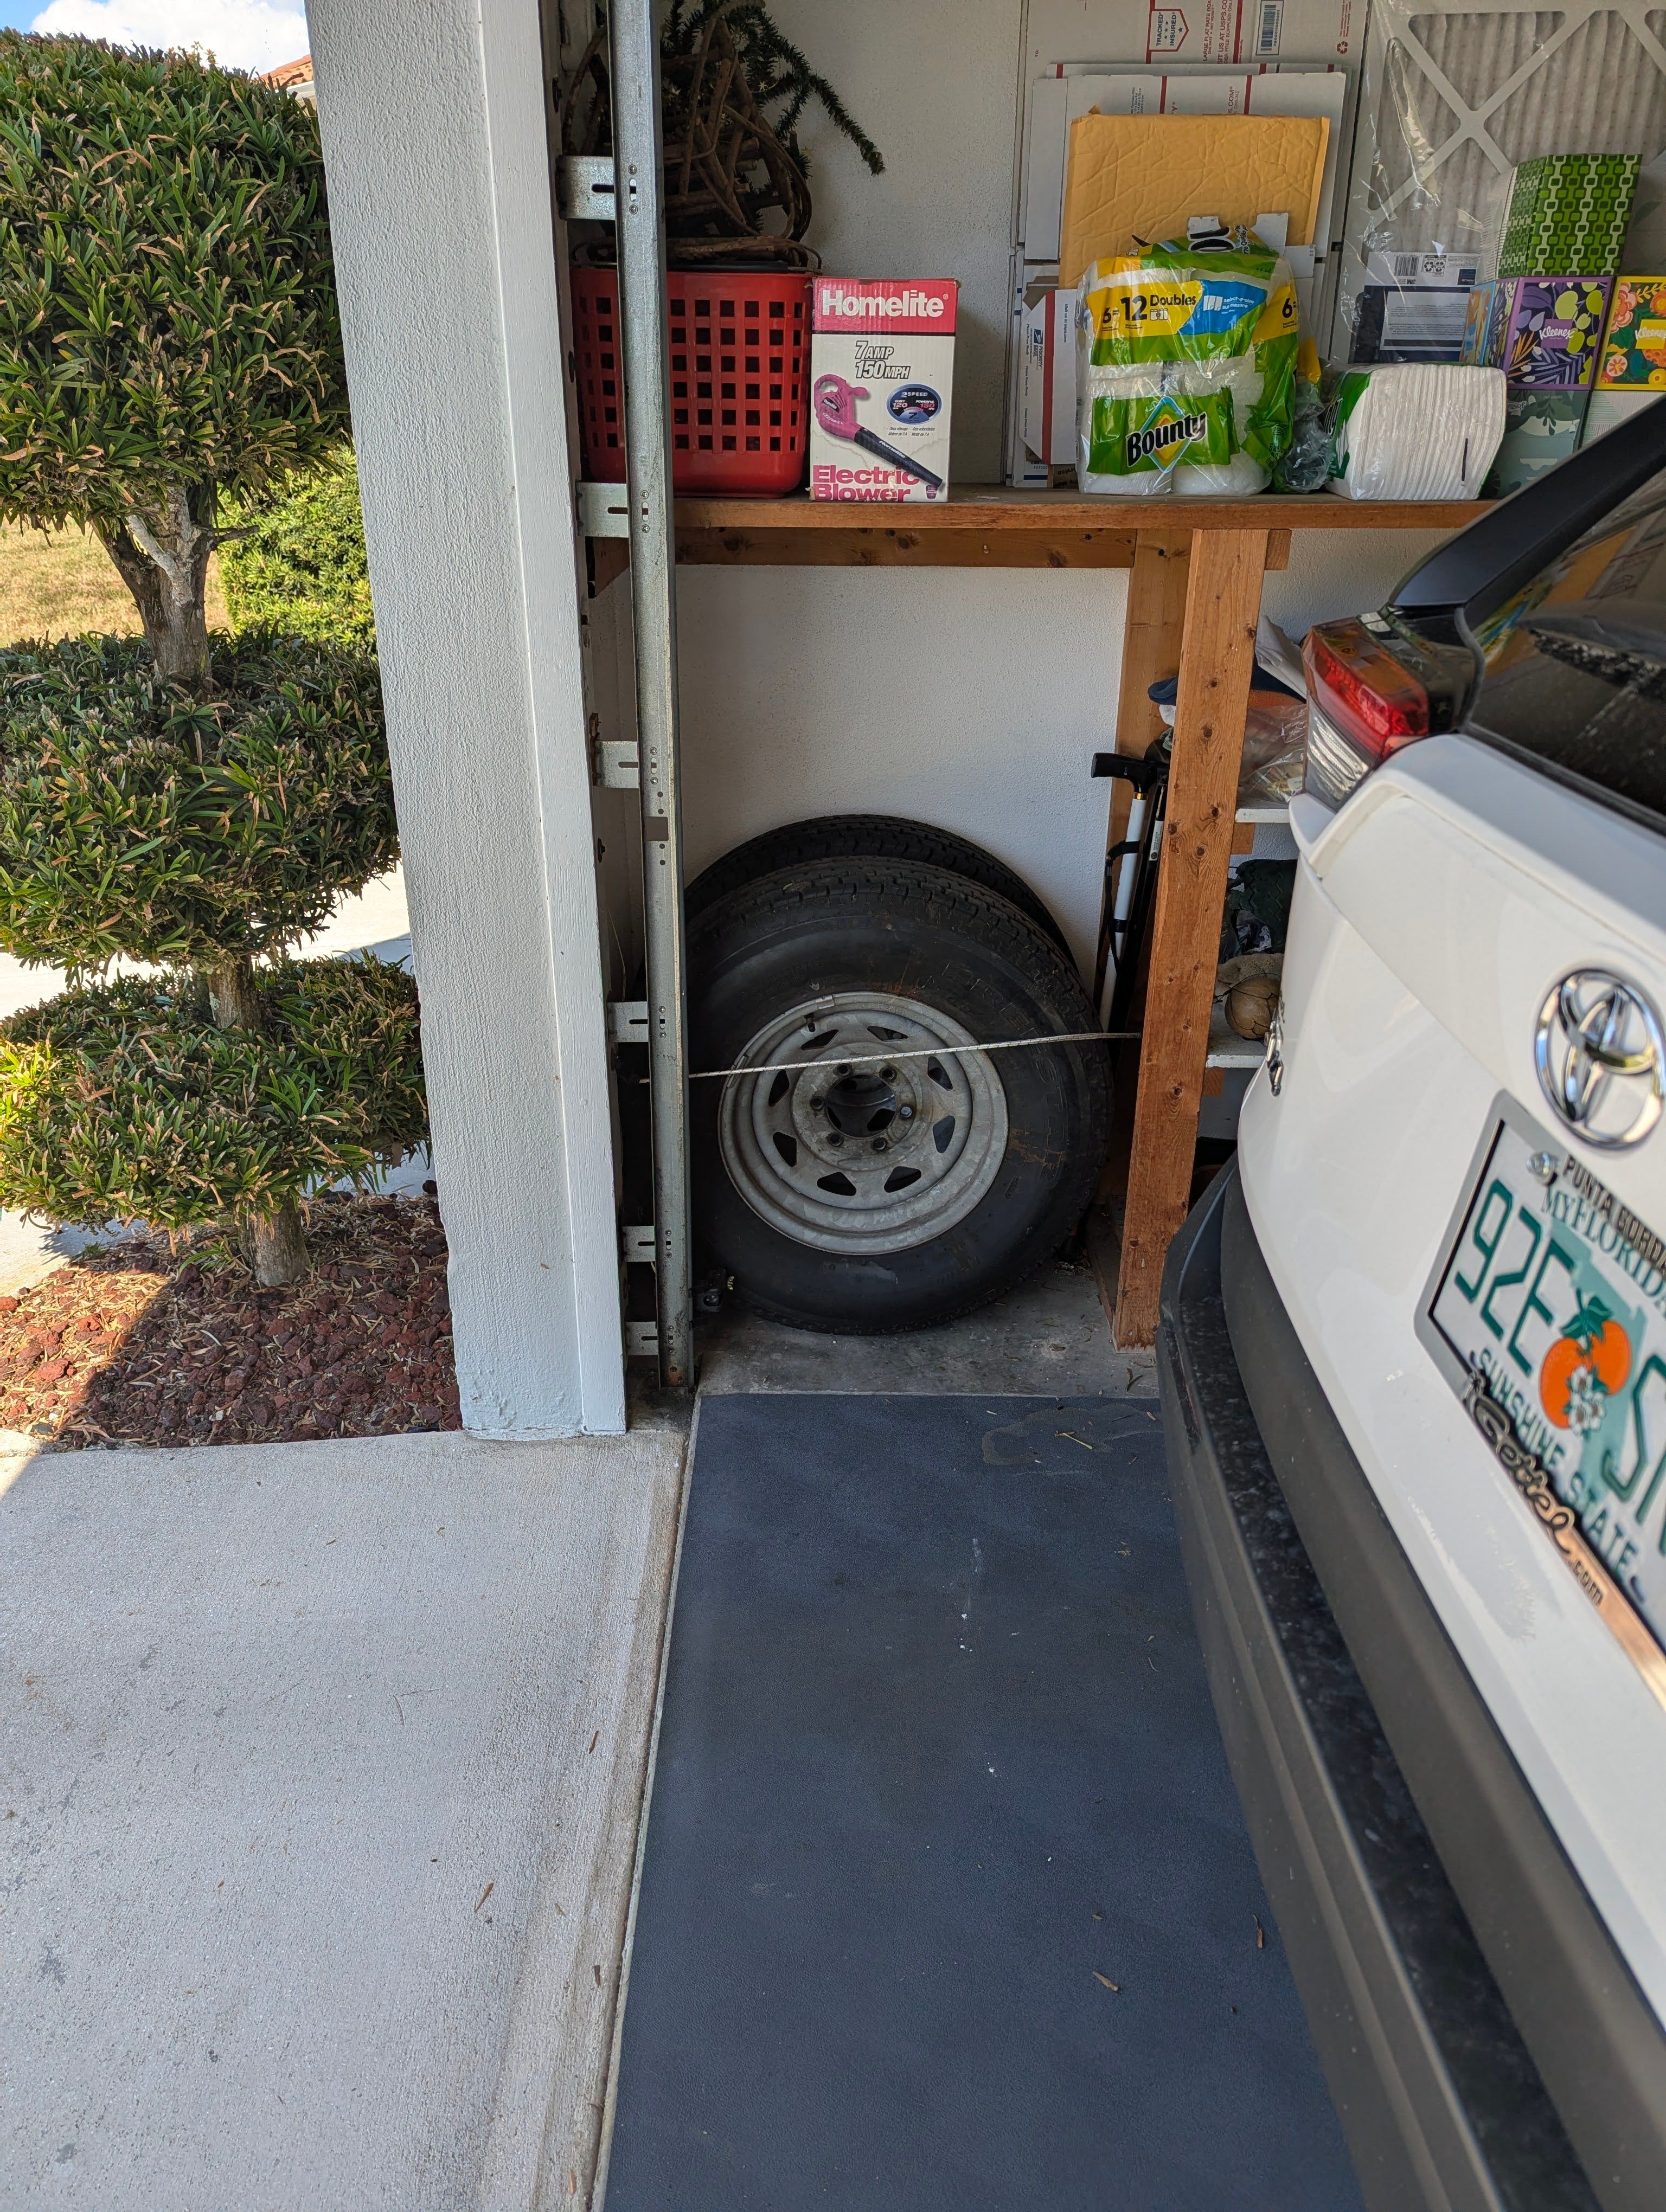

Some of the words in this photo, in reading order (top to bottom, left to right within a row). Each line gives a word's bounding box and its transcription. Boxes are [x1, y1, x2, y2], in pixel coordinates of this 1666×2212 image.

[1219, 41, 1224, 53] US
[1220, 32, 1225, 41] AT
[822, 290, 944, 317] Homelite
[1103, 307, 1112, 324] 6
[1120, 295, 1148, 321] 12
[1150, 293, 1196, 307] Doubles
[1282, 297, 1293, 318] 6
[1539, 326, 1574, 340] Kleenex
[1126, 412, 1207, 467] Bounty
[813, 465, 920, 485] Electric
[813, 483, 911, 503] Blower
[1562, 1153, 1613, 1221] PUNTA
[1454, 1179, 1575, 1379] 92E
[1473, 1348, 1566, 1469] SUNSHINE
[1566, 1472, 1638, 1572] STATE
